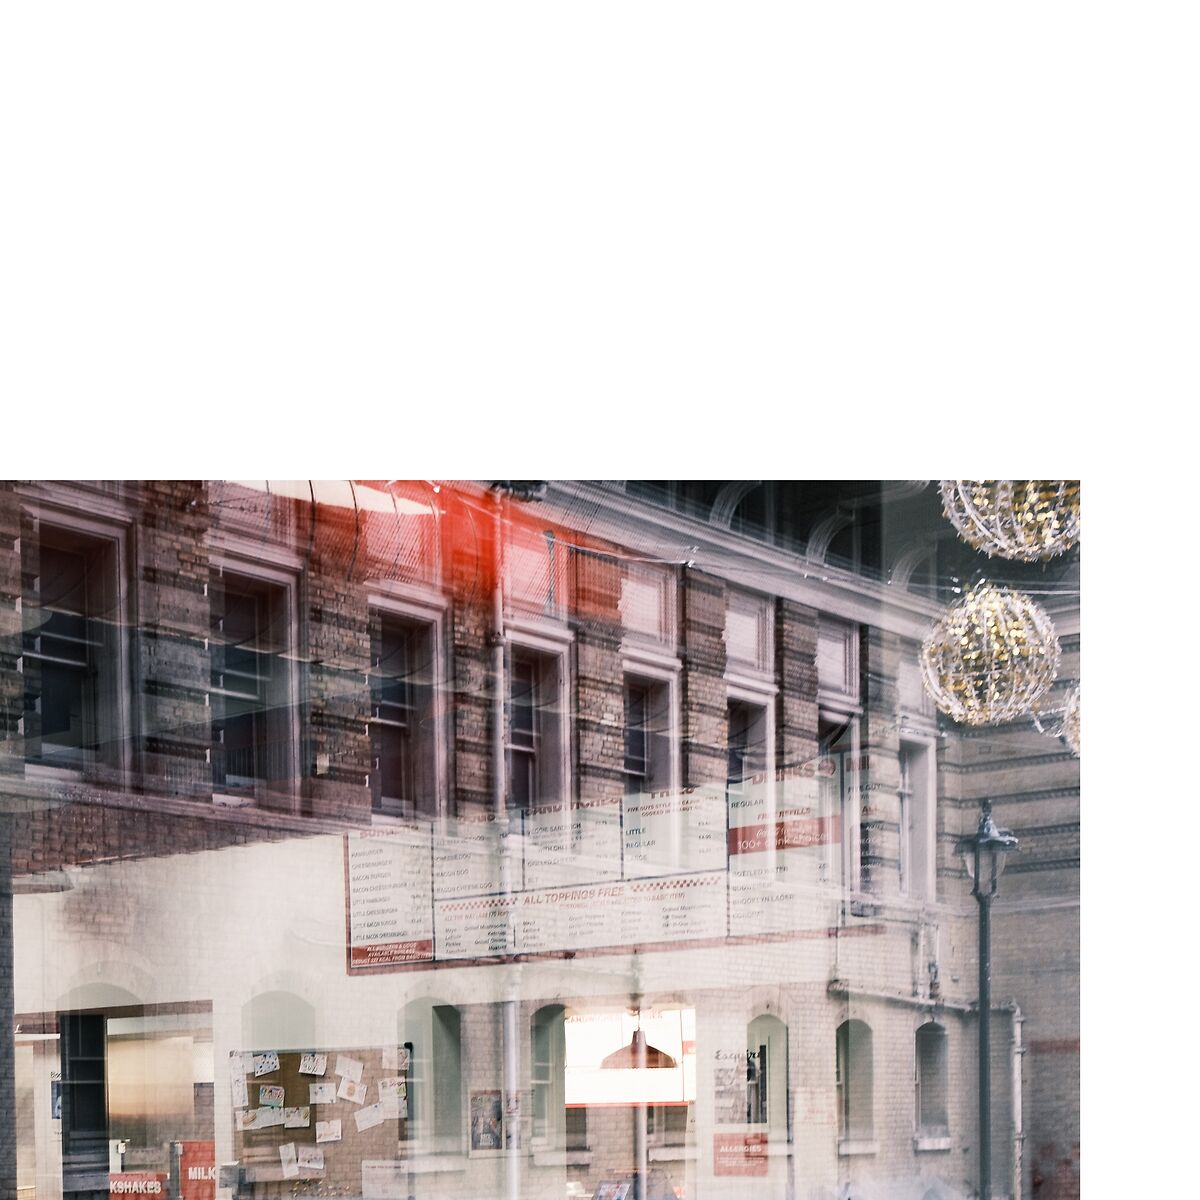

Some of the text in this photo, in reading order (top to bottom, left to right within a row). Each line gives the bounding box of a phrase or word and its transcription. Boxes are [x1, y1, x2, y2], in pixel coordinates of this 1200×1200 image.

[730, 799, 765, 810] REGULAR
[625, 828, 646, 837] LITTLE
[737, 837, 762, 850] 100+
[523, 893, 544, 905] ALL
[544, 889, 597, 903] TOPPINGS
[598, 886, 625, 899] FREE
